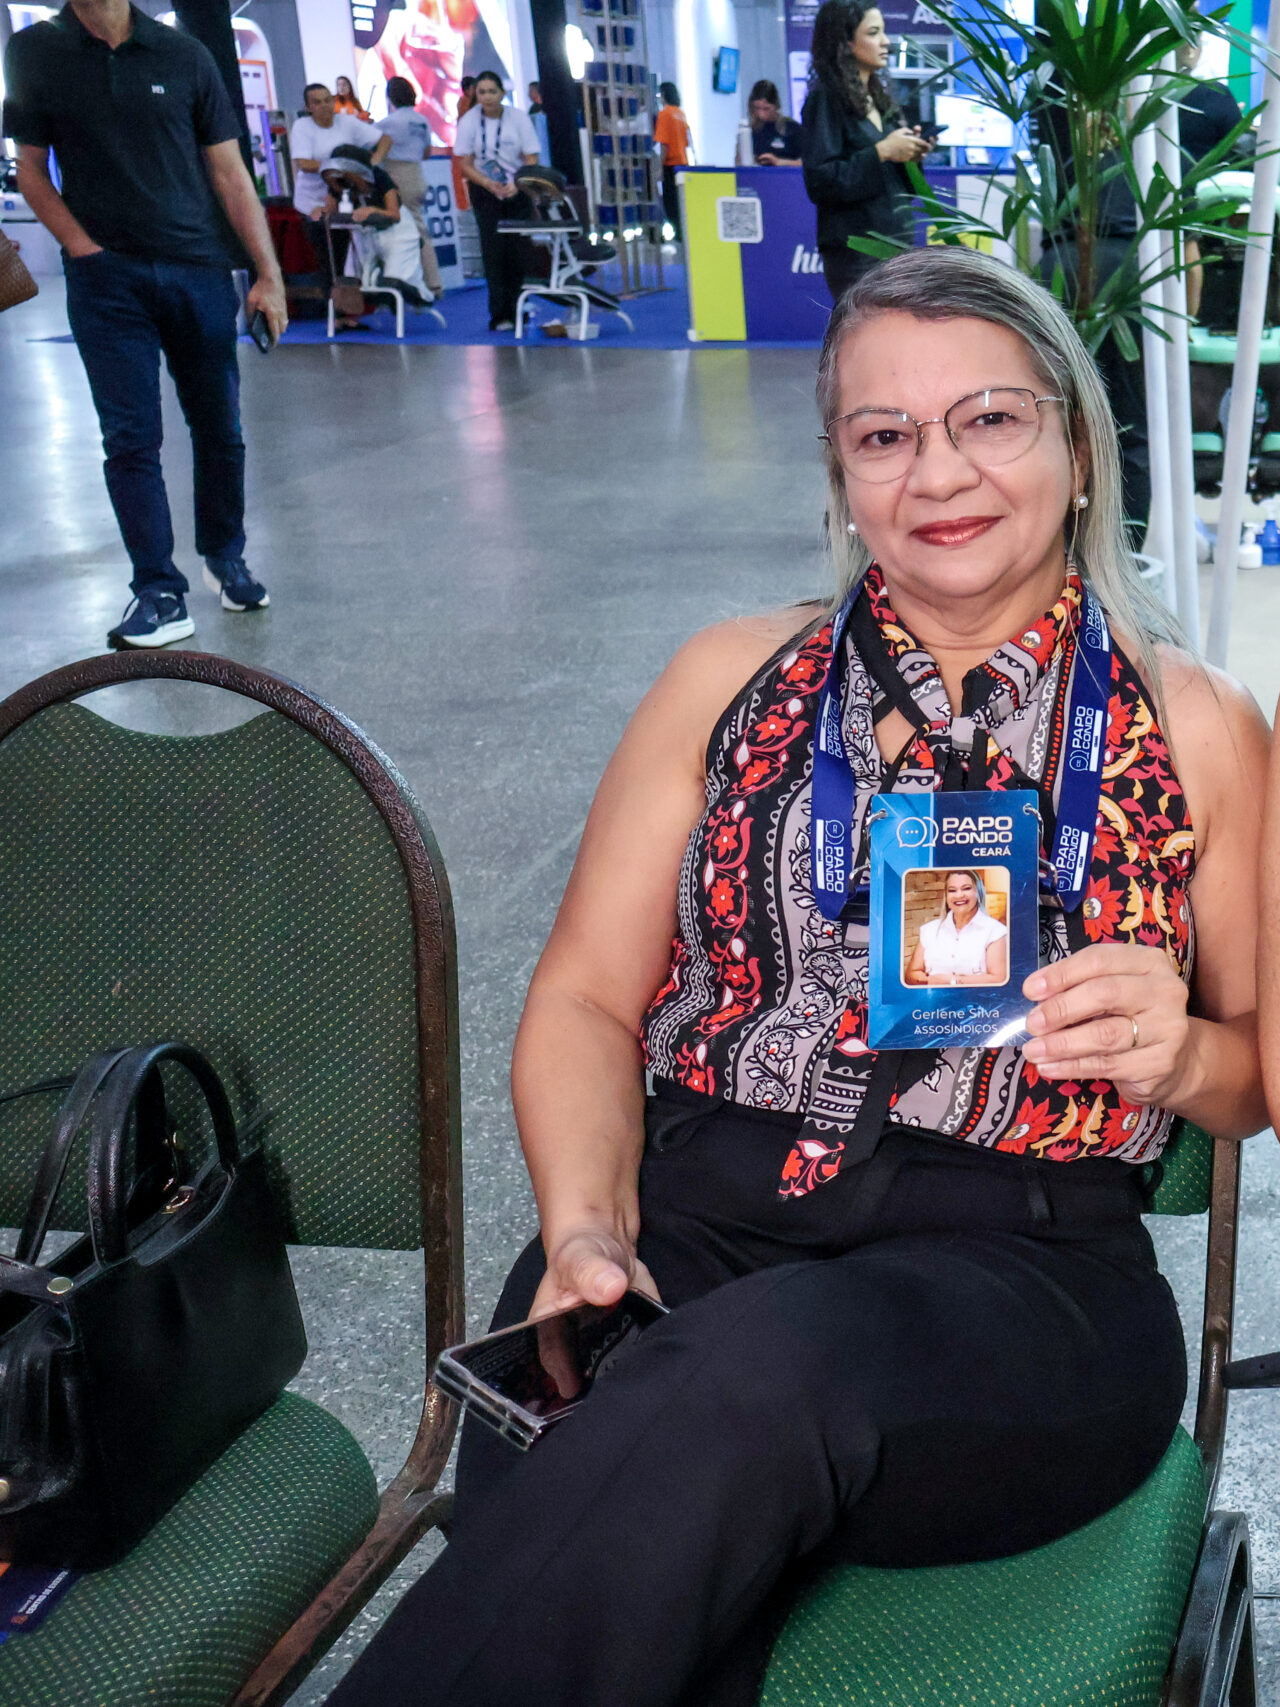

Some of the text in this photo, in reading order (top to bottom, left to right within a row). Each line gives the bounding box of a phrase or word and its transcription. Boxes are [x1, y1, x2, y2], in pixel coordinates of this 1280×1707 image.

[827, 718, 835, 754] CONDO
[832, 722, 843, 758] PAPO
[1072, 706, 1086, 748] PAPO
[1082, 707, 1094, 749] CONDO
[942, 815, 1013, 832] PAPO
[942, 831, 1013, 845] CONDO
[971, 844, 1012, 857] CEARÁ
[1055, 825, 1072, 868] PAPO
[1066, 828, 1080, 870] CONDO
[825, 846, 835, 892] CONDO
[834, 846, 845, 893] PAPO
[912, 1006, 1000, 1020] Gerlene Silva
